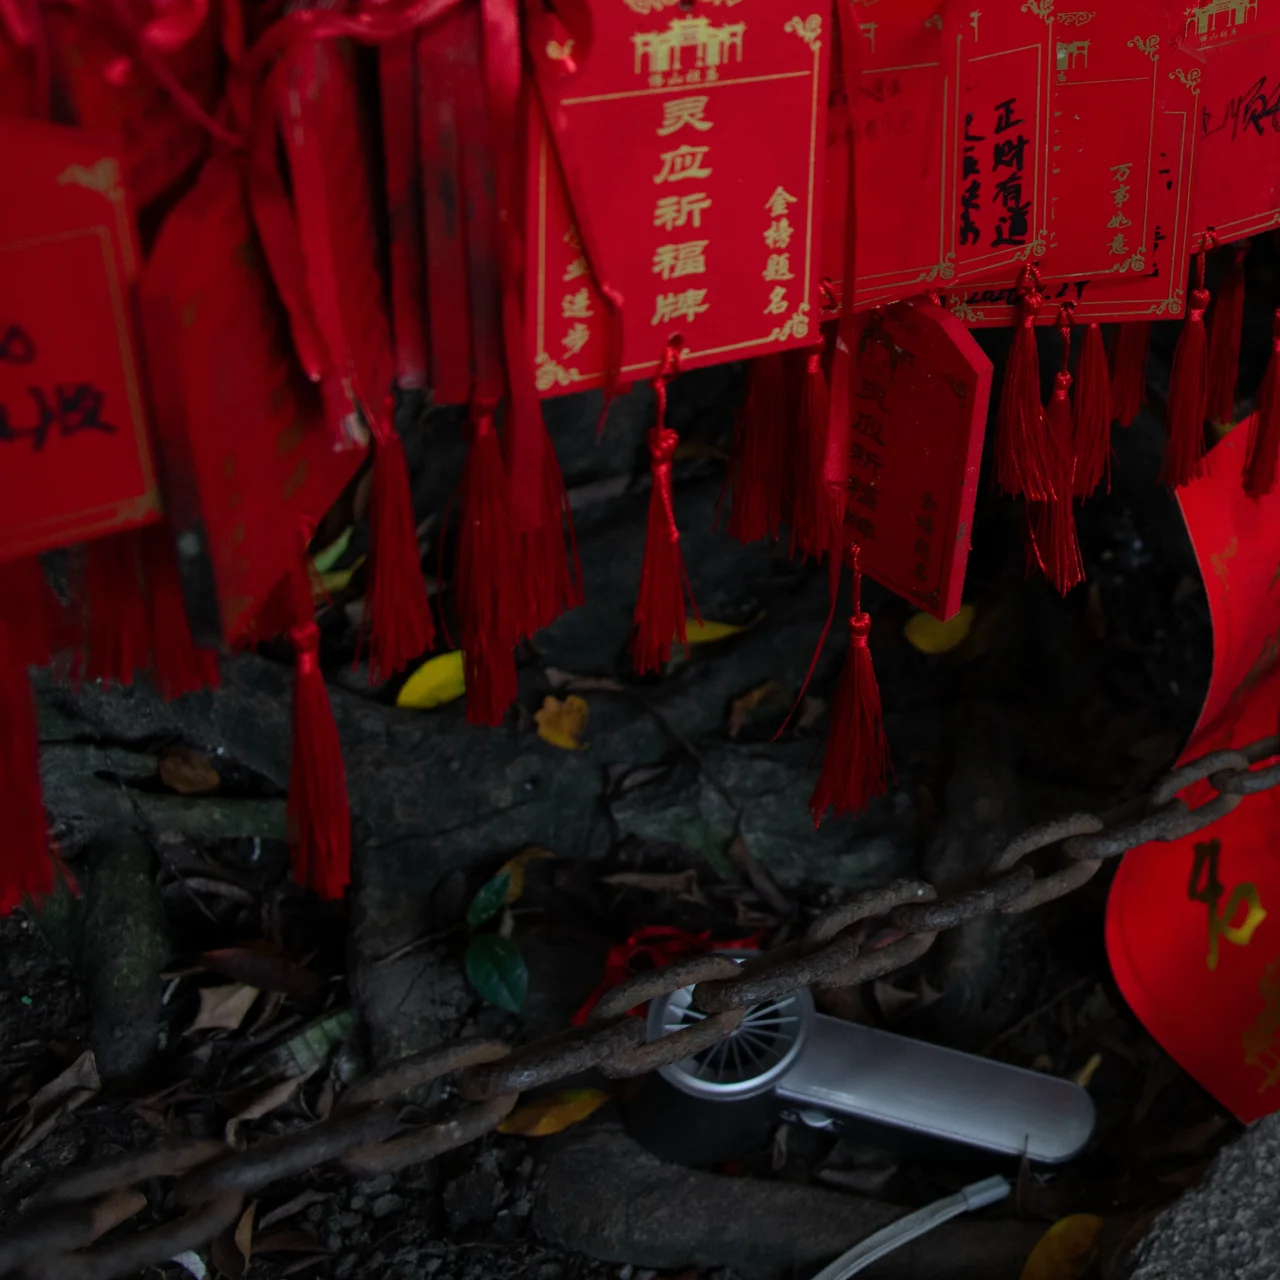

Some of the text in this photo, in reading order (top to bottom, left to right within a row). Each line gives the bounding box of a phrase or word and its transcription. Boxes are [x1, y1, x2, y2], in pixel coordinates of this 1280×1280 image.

[650, 95, 715, 326] 灵应祈福牌
[989, 97, 1032, 248] 正财有道
[1106, 162, 1135, 256] 万事如意
[762, 186, 798, 315] 金榜题名
